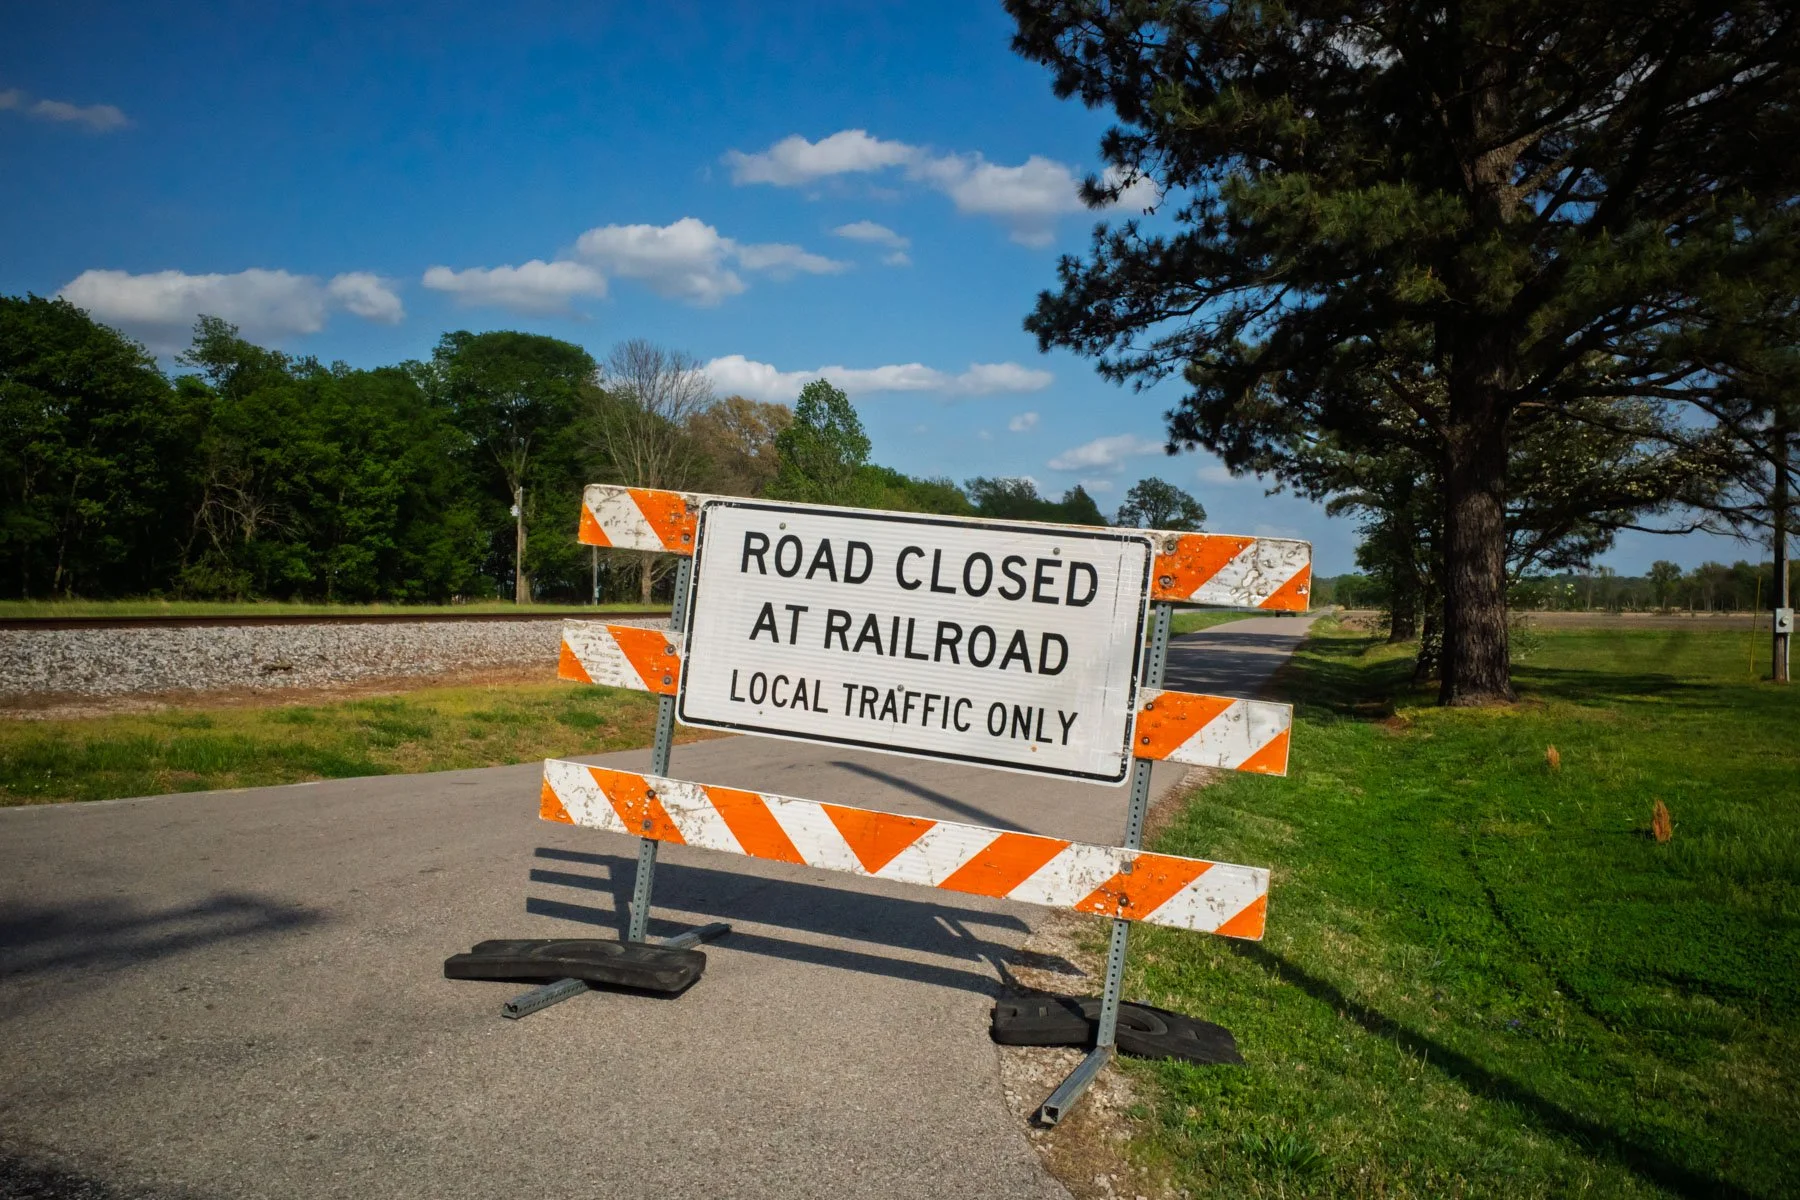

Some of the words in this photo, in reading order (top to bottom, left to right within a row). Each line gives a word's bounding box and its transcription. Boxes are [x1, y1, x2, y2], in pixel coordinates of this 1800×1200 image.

[740, 531, 874, 584] ROAD
[896, 546, 1099, 607] CLOSED
[749, 602, 809, 645] AT
[824, 609, 1068, 676] RAILROAD
[730, 669, 829, 714] LOCAL
[843, 683, 973, 732] TRAFFIC
[987, 702, 1079, 746] ONLY
